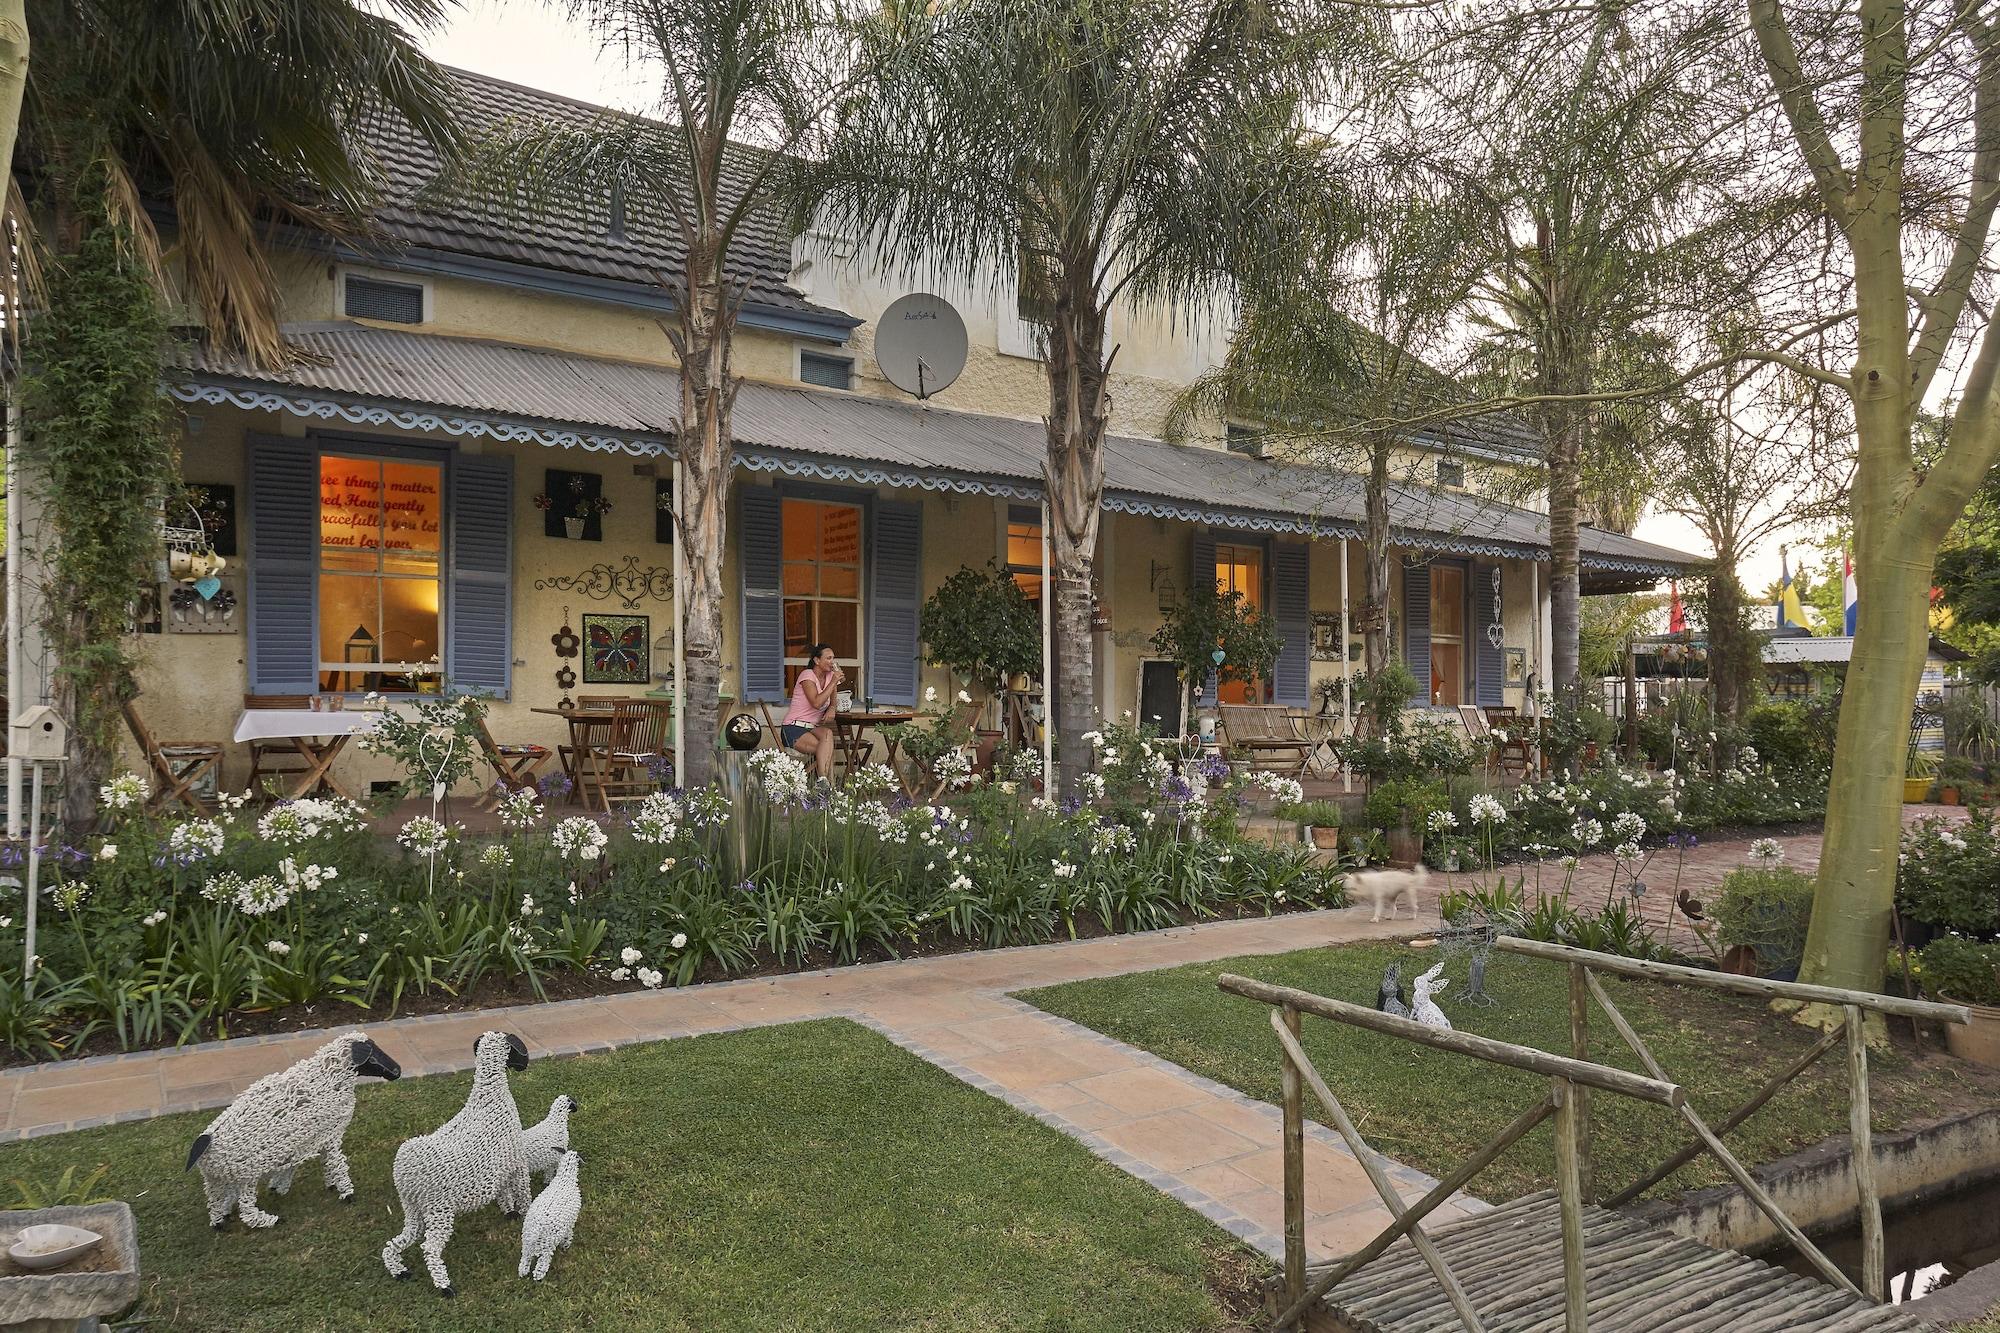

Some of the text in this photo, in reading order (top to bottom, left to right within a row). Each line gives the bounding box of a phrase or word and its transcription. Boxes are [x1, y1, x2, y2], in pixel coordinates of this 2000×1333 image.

[345, 494, 380, 509] How
[383, 500, 425, 515] gently
[320, 513, 387, 529] racefull
[391, 519, 416, 531] you
